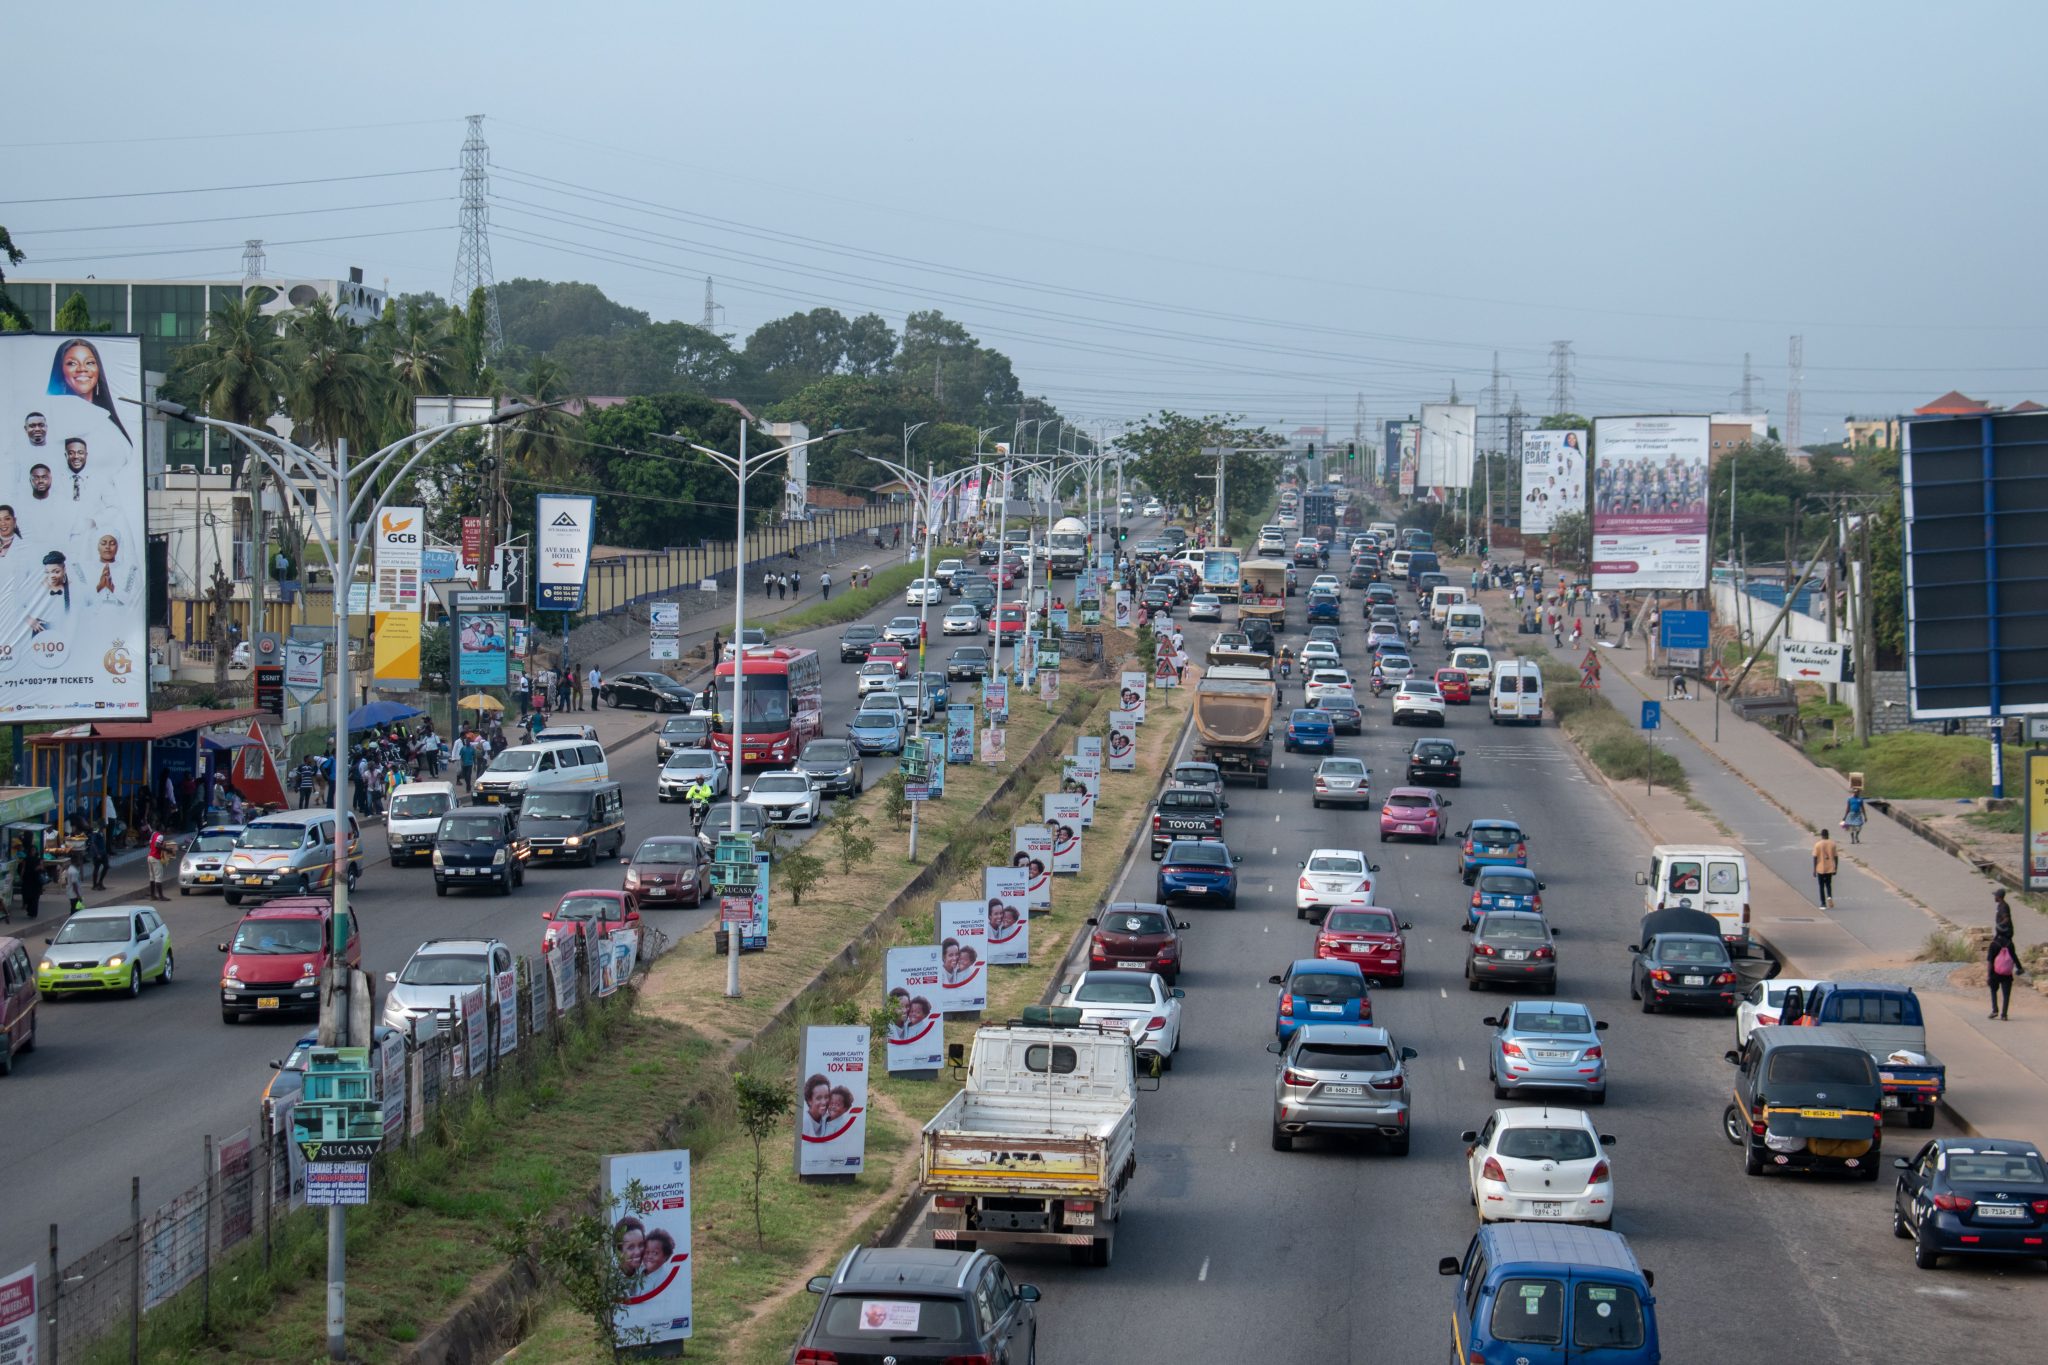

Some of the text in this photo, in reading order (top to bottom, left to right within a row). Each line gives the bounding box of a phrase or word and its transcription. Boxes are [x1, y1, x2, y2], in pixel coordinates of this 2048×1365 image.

[388, 534, 416, 543] GCB
[426, 552, 454, 562] PLAZA
[1784, 644, 1806, 654] Wild
[1646, 710, 1655, 721] P
[1169, 820, 1206, 829] TOYOTA
[957, 928, 970, 936] 10X
[827, 1063, 844, 1072] 10X
[322, 1145, 372, 1156] SUCASA
[309, 1164, 366, 1173] LEAKAGE SPECIALIST
[646, 1190, 684, 1198] PROTECTION
[336, 1196, 366, 1204] Painting
[1534, 1208, 1561, 1216] 9894-21
[1991, 1207, 2016, 1216] 7134-18
[0, 1286, 22, 1300] CENTRAL
[2, 1295, 30, 1315] UNIVERSITY
